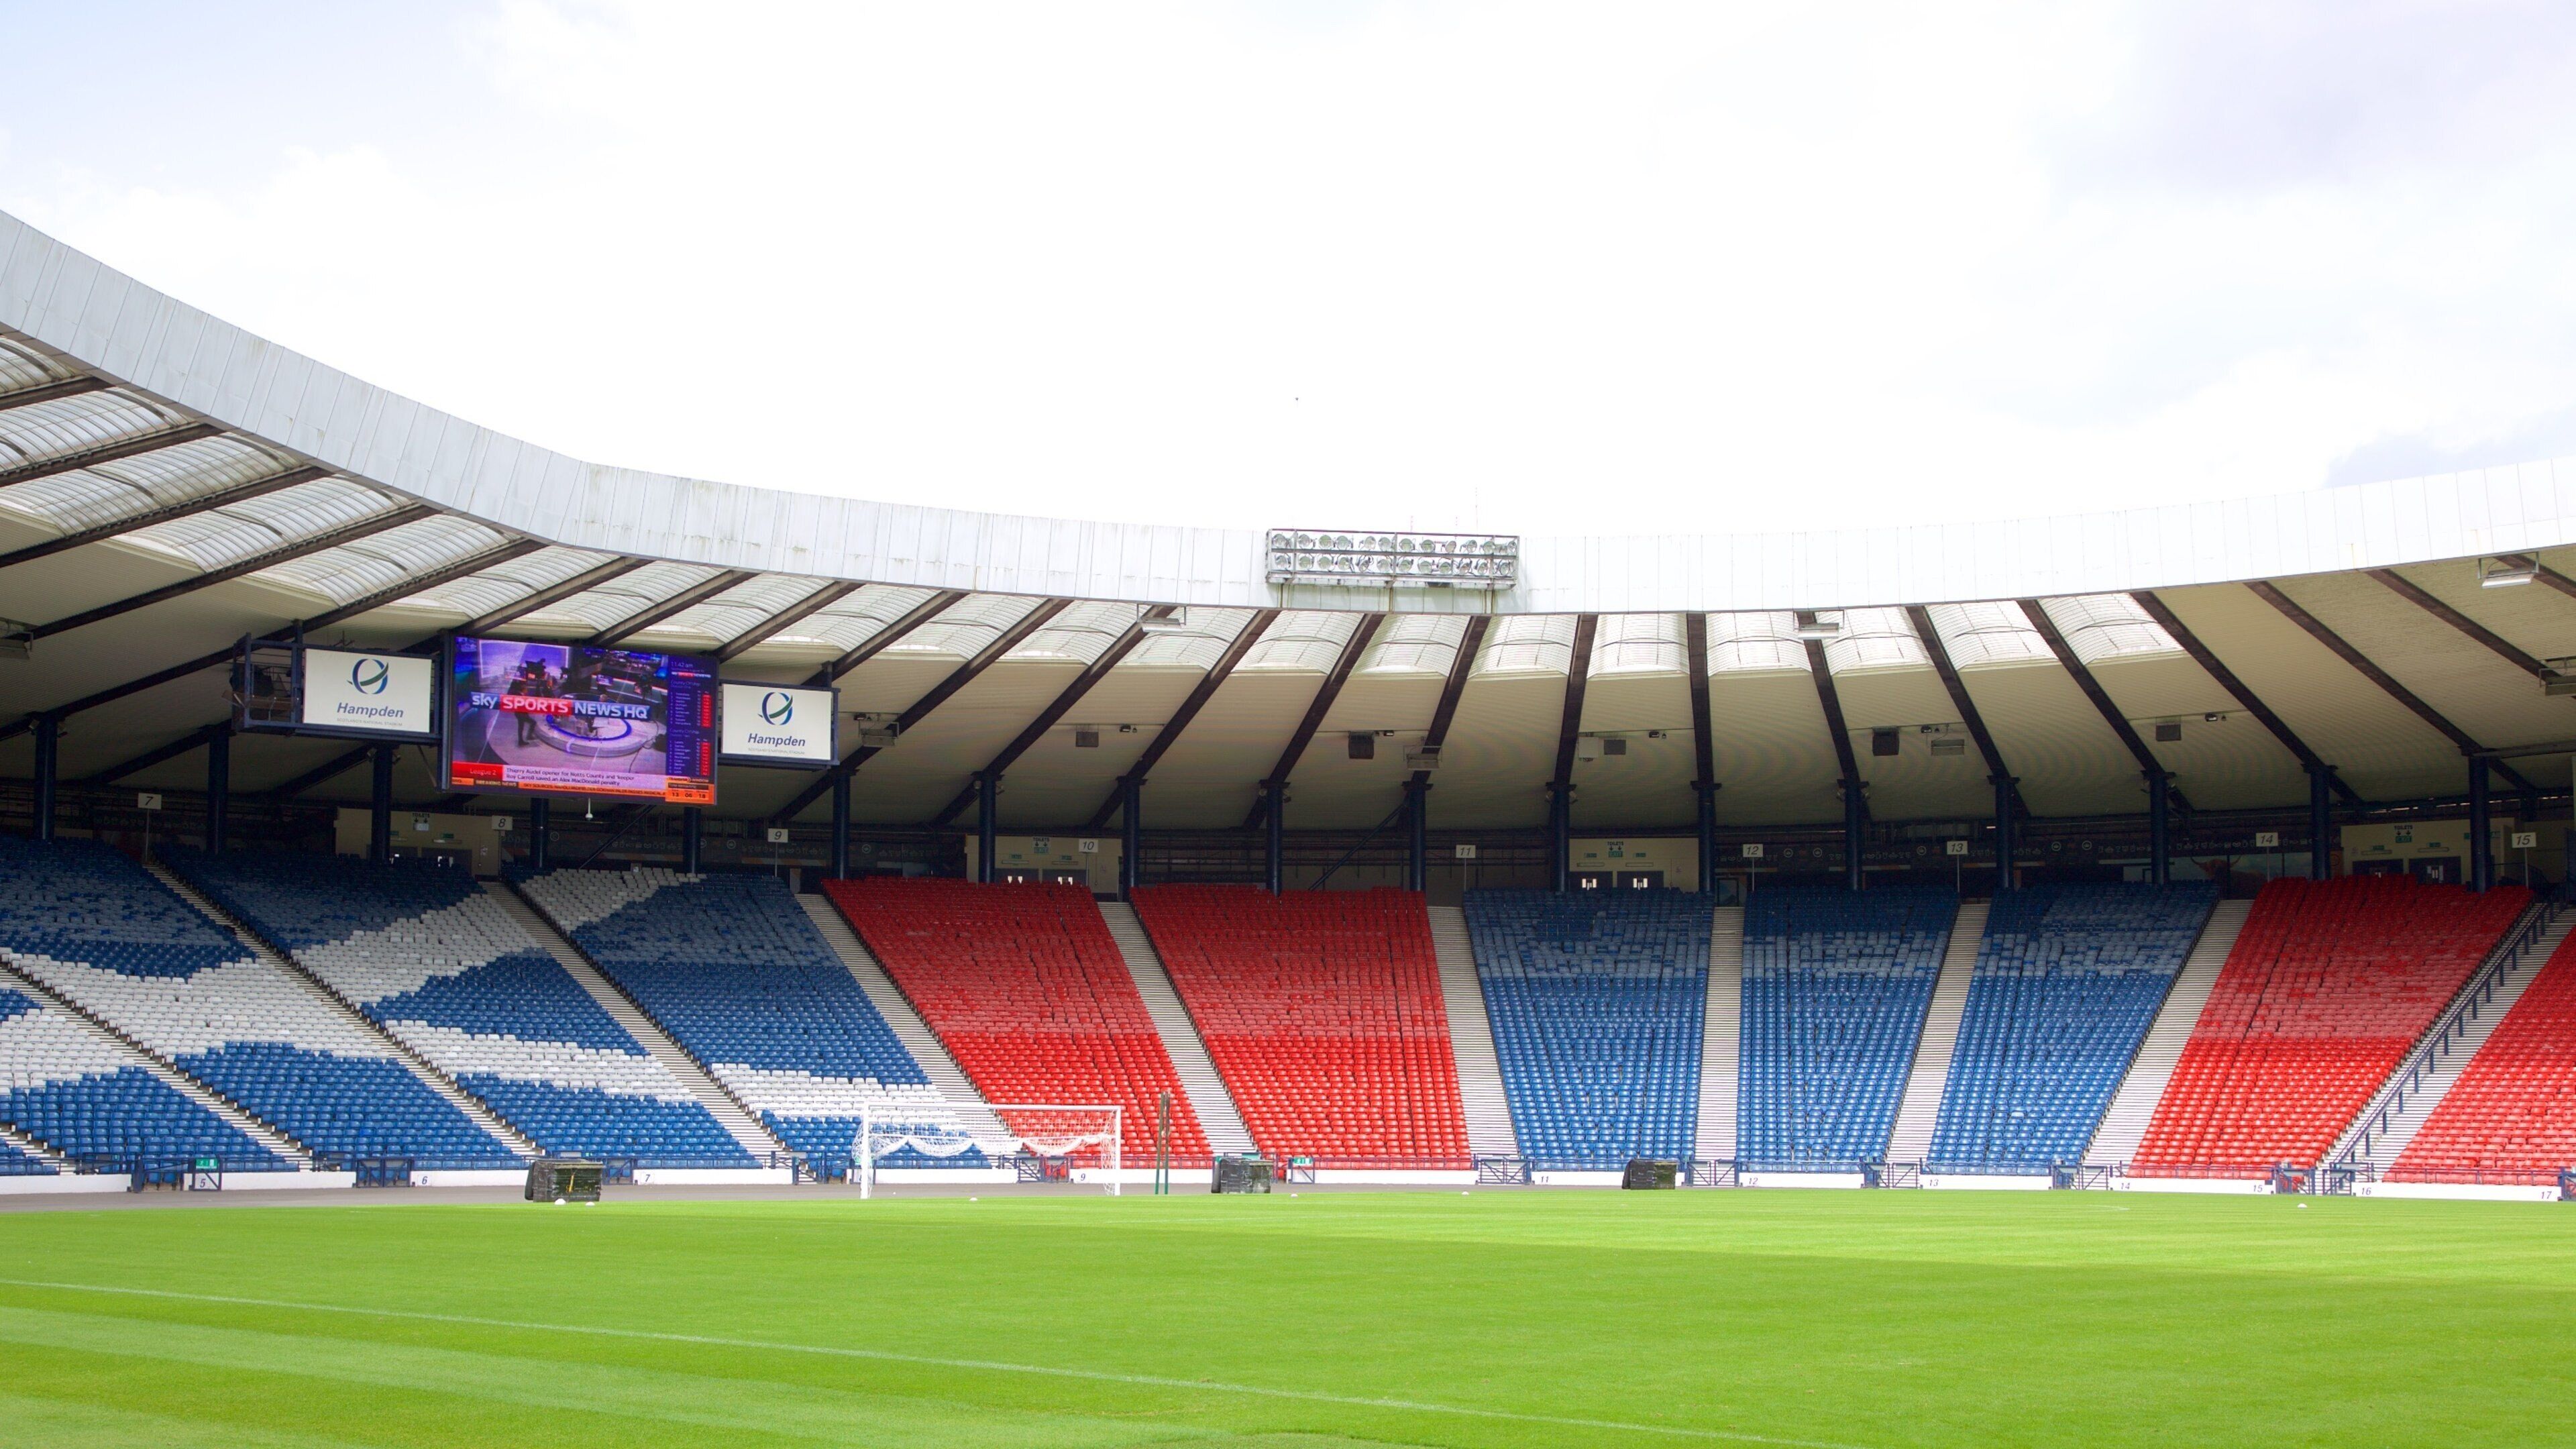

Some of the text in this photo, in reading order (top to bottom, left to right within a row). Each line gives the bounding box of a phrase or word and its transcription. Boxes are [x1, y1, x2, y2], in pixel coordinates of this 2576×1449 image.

[337, 702, 404, 718] Hampden
[472, 693, 648, 719] sky SPORTS NEWS HQ
[747, 733, 806, 747] Hampden
[470, 767, 491, 776] League
[145, 796, 154, 806] 7
[498, 818, 506, 828] 8
[774, 831, 782, 841] 9
[2261, 835, 2274, 845] 14
[2516, 835, 2532, 846] 15
[1083, 841, 1095, 851] 10
[1951, 843, 1964, 853] 13
[1460, 847, 1472, 856] 11
[1747, 846, 1760, 856] 12
[421, 1176, 428, 1185] 6
[645, 1174, 651, 1183] 7
[1080, 1173, 1087, 1182] 9
[1540, 1176, 1550, 1184] 11
[1748, 1177, 1760, 1185] 12
[199, 1178, 207, 1188] 5
[1929, 1179, 1939, 1187] 13
[2121, 1183, 2131, 1191] 14
[2253, 1184, 2263, 1193] 15
[2361, 1187, 2372, 1196] 16
[2541, 1191, 2553, 1200] 17
